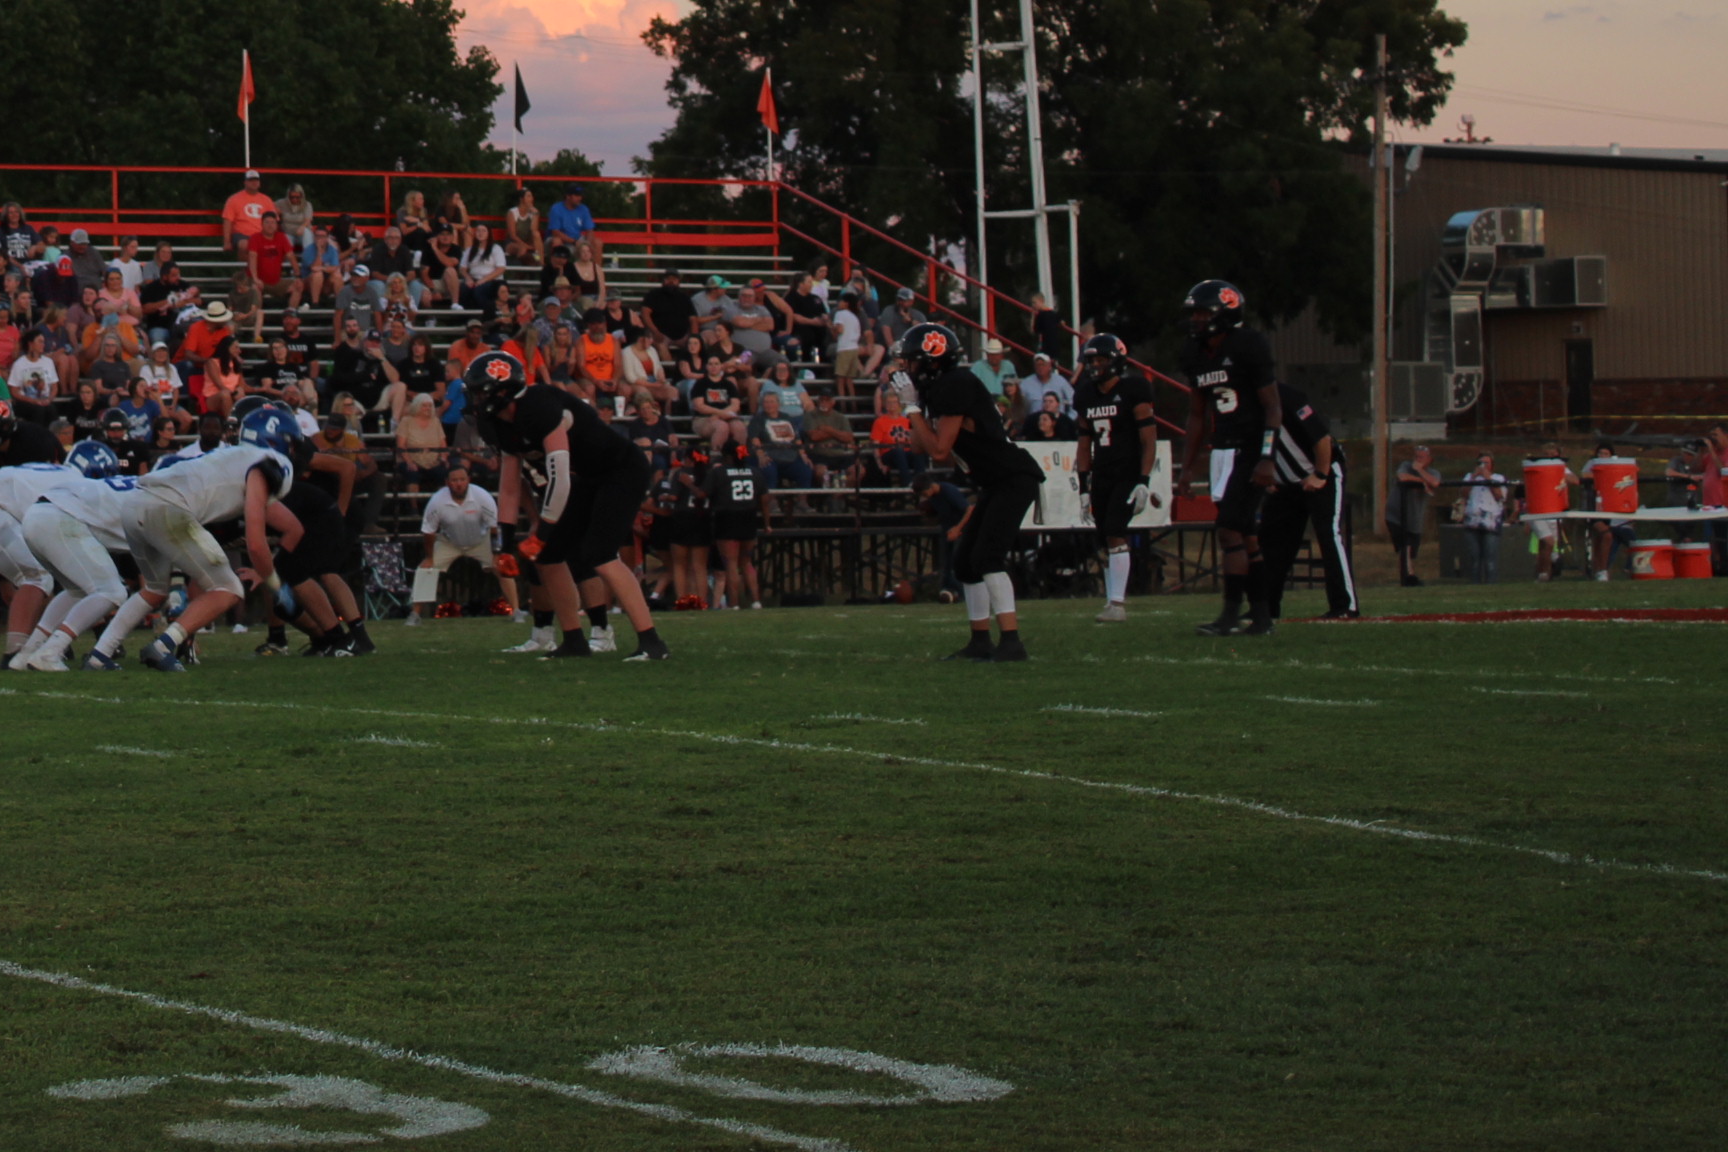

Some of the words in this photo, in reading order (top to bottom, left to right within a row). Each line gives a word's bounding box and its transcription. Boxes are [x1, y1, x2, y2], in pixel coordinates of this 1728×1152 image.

[1195, 369, 1228, 387] MAUD
[1212, 386, 1238, 414] 3
[1086, 404, 1118, 419] MAUD
[1093, 418, 1112, 447] 7
[731, 479, 754, 501] 23
